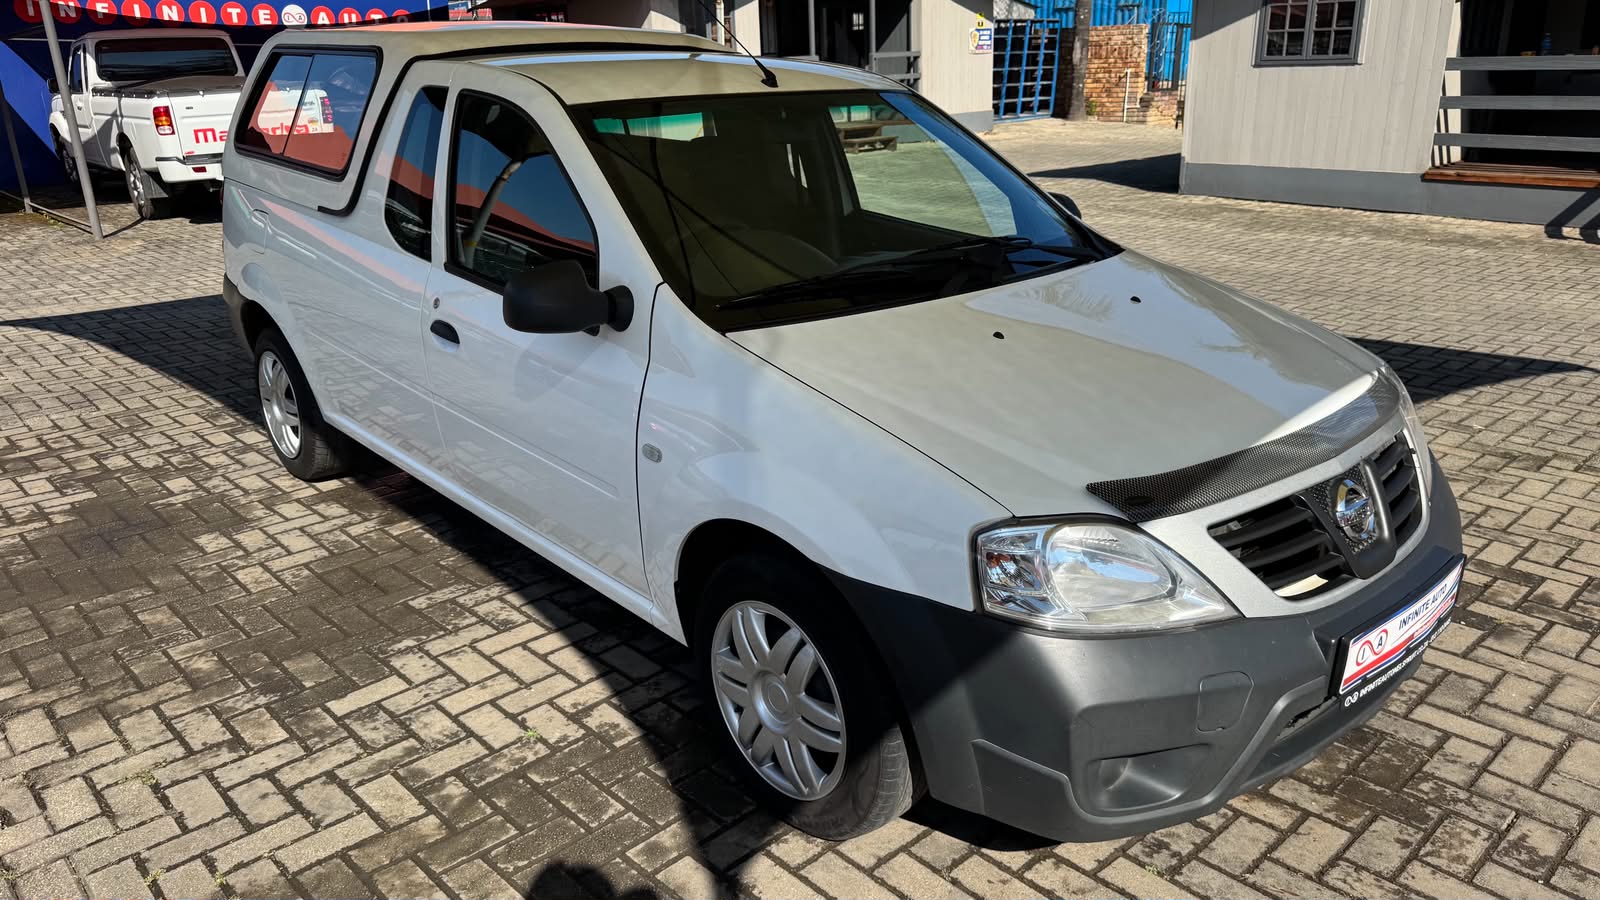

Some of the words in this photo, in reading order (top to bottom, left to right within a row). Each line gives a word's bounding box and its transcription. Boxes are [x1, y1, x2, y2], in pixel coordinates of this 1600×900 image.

[26, 0, 272, 26] INFINITE
[1399, 598, 1430, 631] INFINITE
[1430, 584, 1448, 606] AUTO
